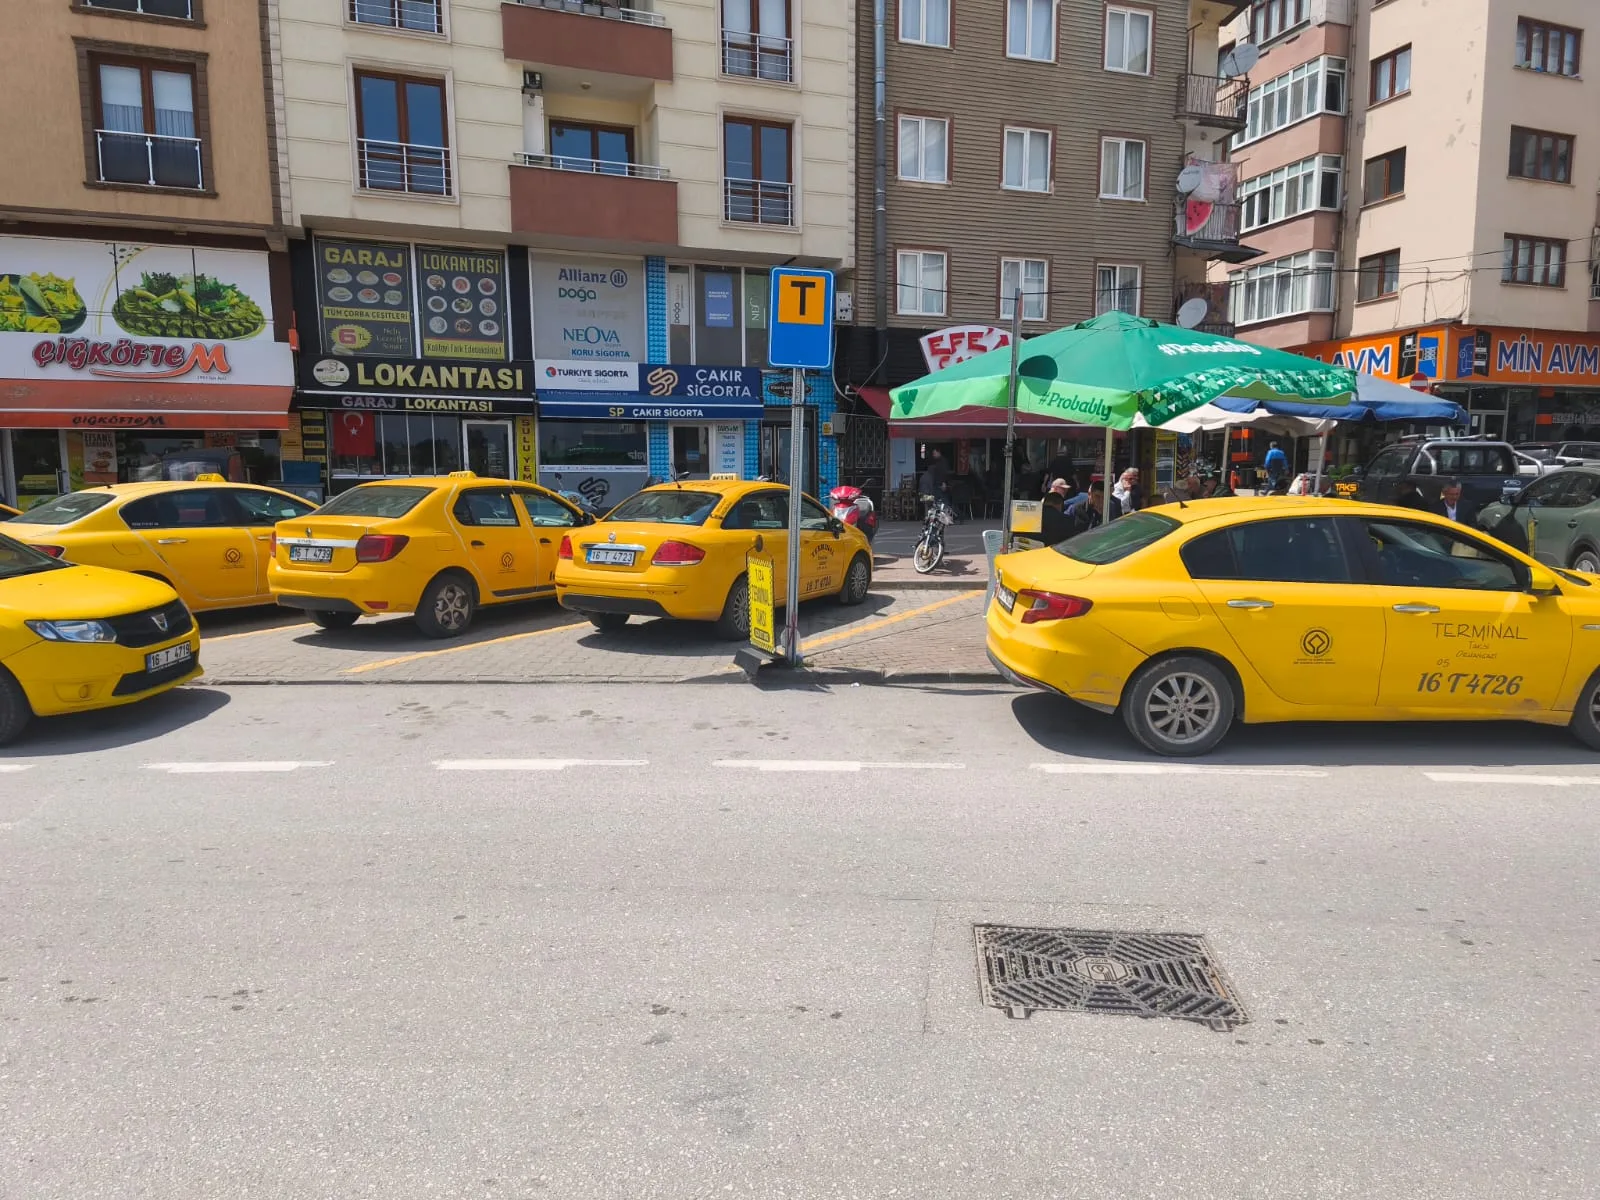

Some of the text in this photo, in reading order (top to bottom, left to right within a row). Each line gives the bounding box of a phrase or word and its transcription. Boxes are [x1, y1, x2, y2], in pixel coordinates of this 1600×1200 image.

[325, 247, 404, 269] GARAJ
[423, 253, 501, 275] LOKANTASI
[558, 268, 607, 284] Allianz
[790, 280, 817, 316] T
[338, 328, 357, 346] 6
[563, 326, 620, 344] NEOVA
[571, 348, 630, 359] KORU SİGORTA
[1331, 344, 1393, 375] AVM
[1496, 334, 1600, 375] MİN AVM
[356, 362, 525, 390] LOKANTASI
[695, 369, 742, 385] ÇAKIR
[687, 384, 752, 399] SİGORTA
[341, 396, 493, 412] GARAJ LOKANTASI
[609, 407, 704, 420] SP ÇAKIR SİGORTA
[1038, 391, 1113, 422] #Probably
[592, 551, 633, 562] 16 T 4723
[1432, 622, 1529, 641] TERMİNAL
[152, 643, 190, 668] 16 T 4719
[1416, 671, 1524, 696] 16 T 4726
